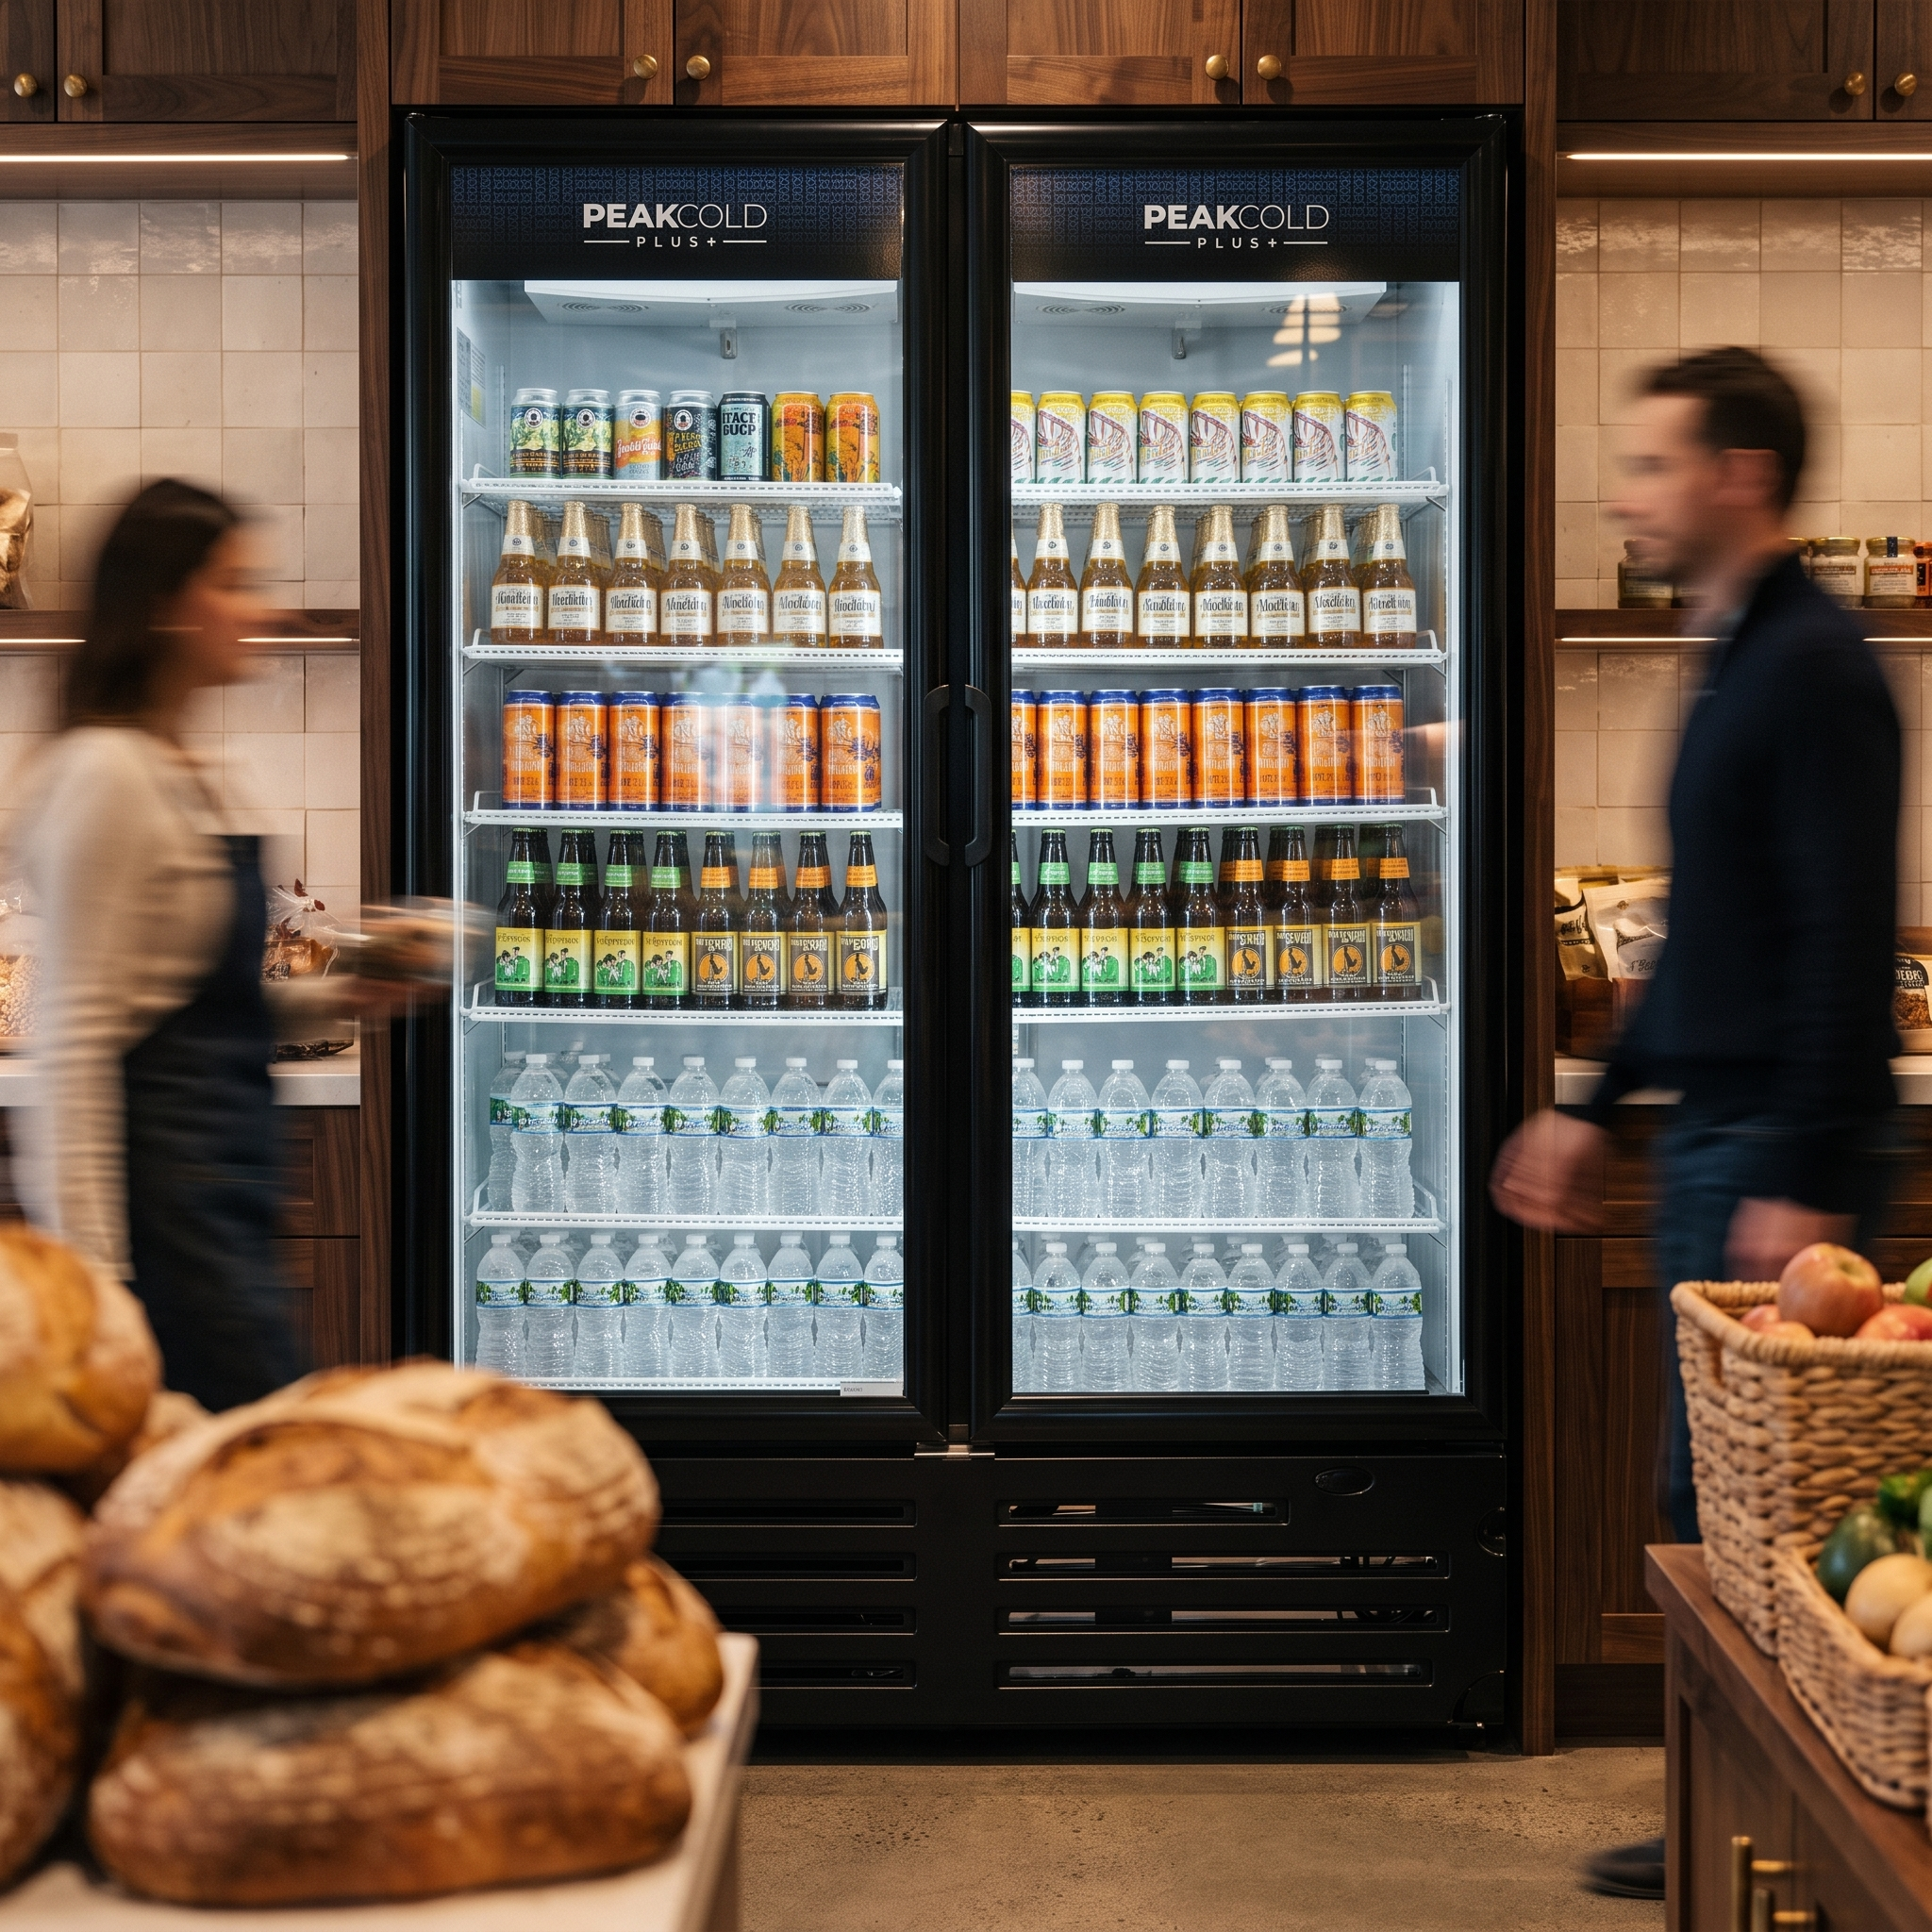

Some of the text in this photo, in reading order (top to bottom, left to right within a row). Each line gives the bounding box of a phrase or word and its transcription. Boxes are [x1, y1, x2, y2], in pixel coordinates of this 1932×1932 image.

[583, 203, 768, 228] PEAKCOLD
[1143, 205, 1329, 230] PEAKCOLD
[637, 236, 716, 247] PLUS+
[1197, 238, 1277, 249] PLUS+
